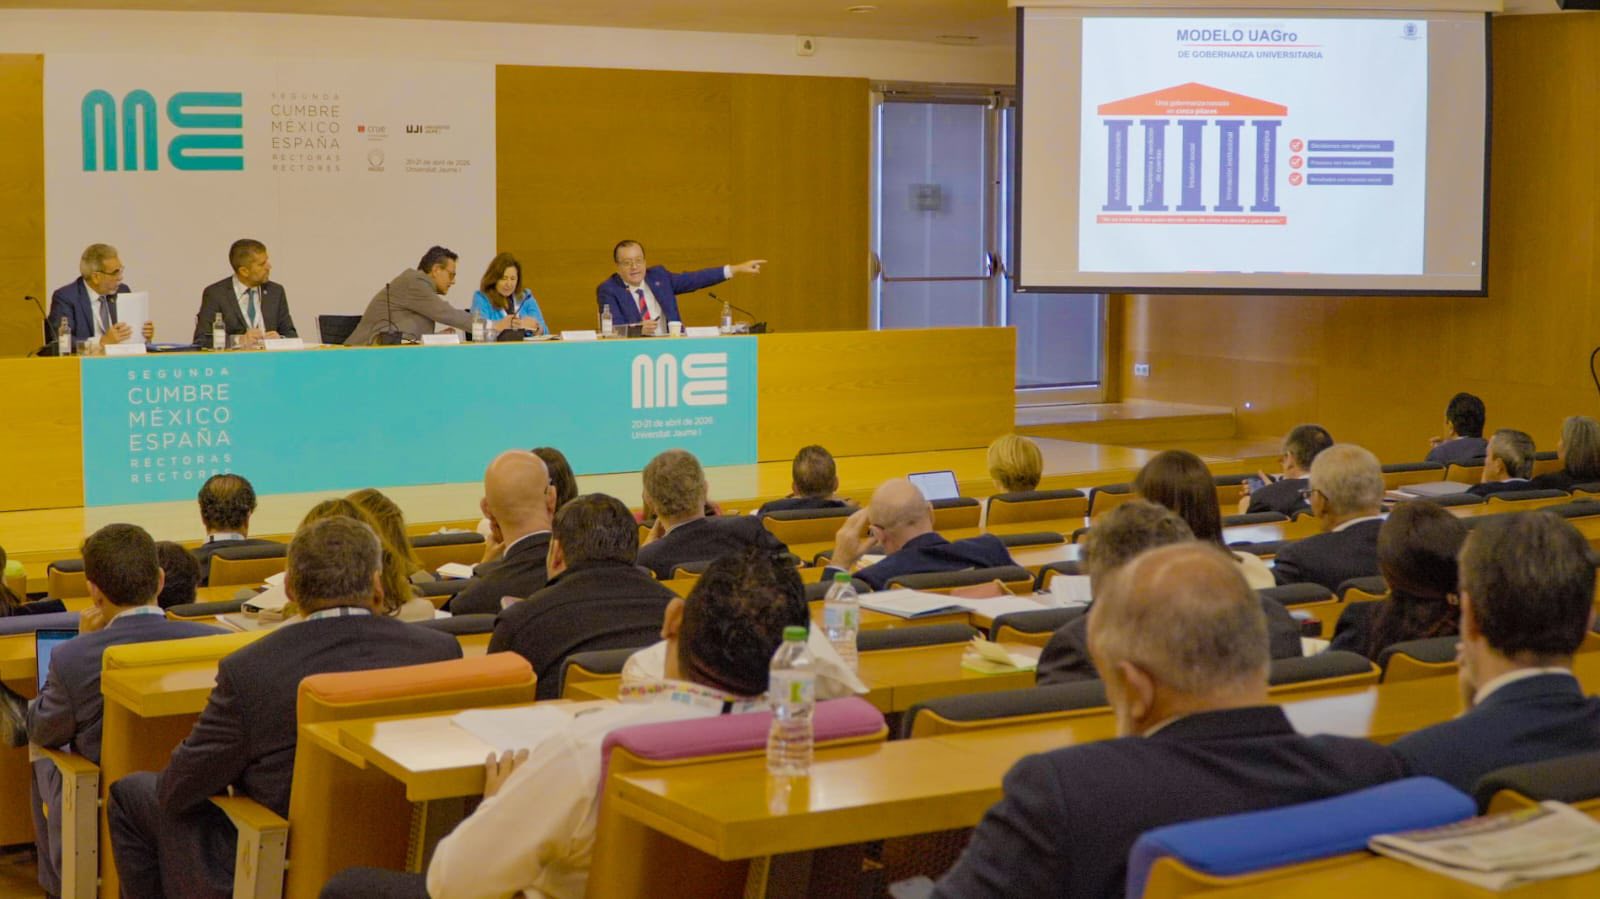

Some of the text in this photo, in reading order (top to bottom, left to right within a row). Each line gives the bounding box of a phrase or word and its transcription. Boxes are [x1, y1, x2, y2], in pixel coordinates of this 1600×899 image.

[1176, 29, 1298, 42] MODELO UAGro
[1177, 50, 1323, 60] DE GOBERNANZA UNIVERSITARIA
[271, 92, 339, 100] SEGUNDA
[271, 104, 340, 118] CUMBRE
[406, 125, 423, 134] UJI
[271, 135, 340, 149] ESPAÑA
[271, 153, 340, 162] RECTORAS
[272, 164, 340, 172] RECTORES
[128, 367, 229, 380] SEGUNDA
[128, 383, 230, 405] CUMBRE
[129, 406, 230, 428] MÉXICO
[655, 419, 664, 427] de
[666, 418, 682, 426] abril
[130, 427, 231, 451] ESPAÑA
[632, 430, 671, 439] Universitat
[673, 428, 698, 437] Jaume
[130, 453, 232, 468] RECTORAS
